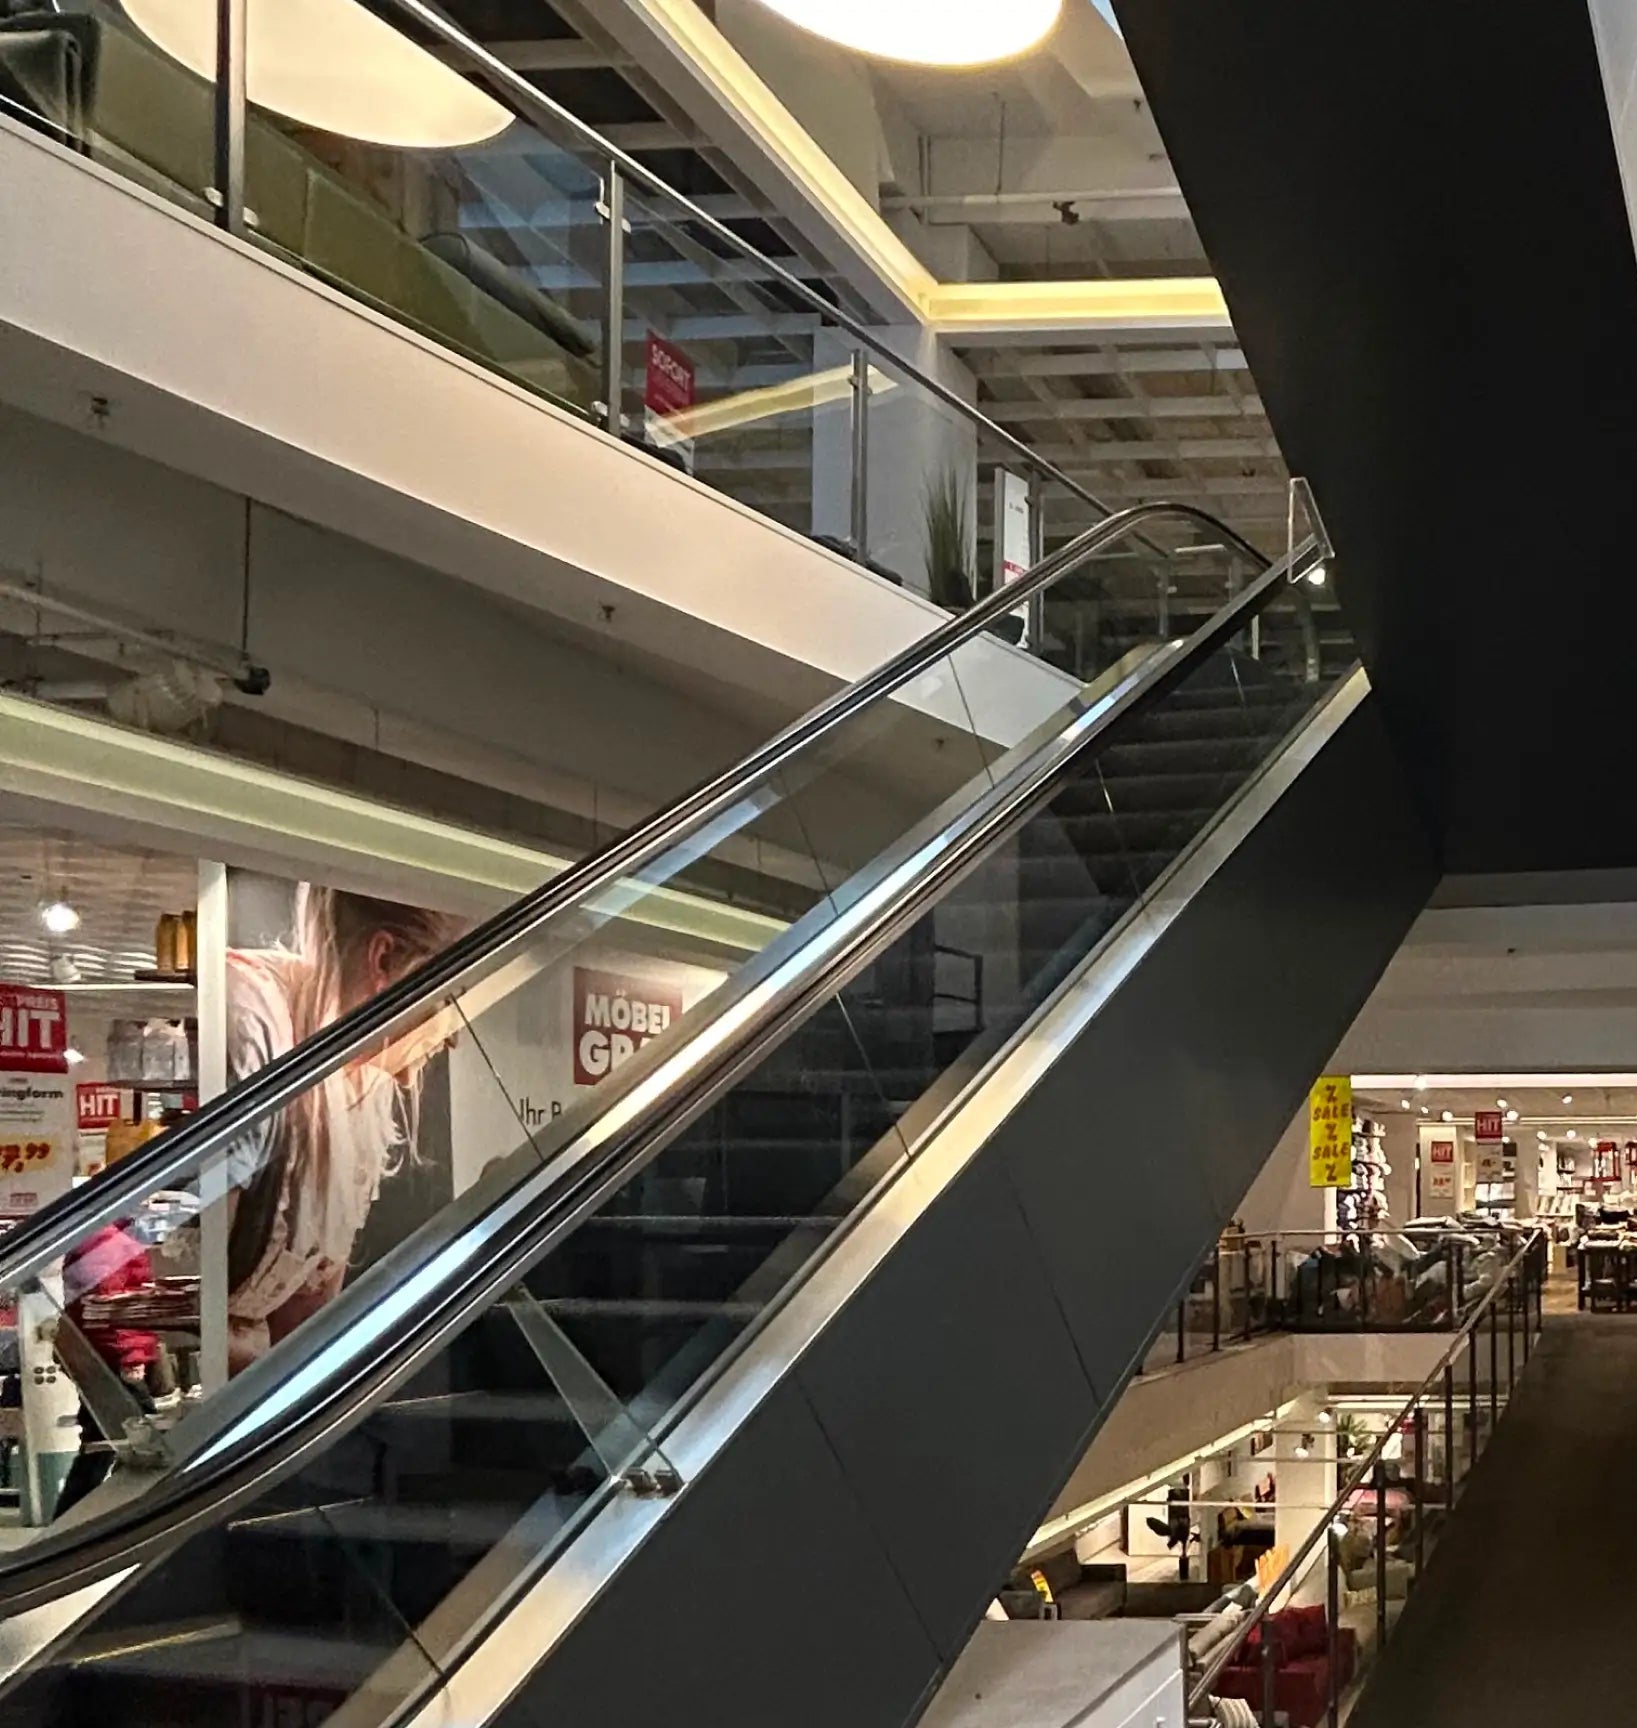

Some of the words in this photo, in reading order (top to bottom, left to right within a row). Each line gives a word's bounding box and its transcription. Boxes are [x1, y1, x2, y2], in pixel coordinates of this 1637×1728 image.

[80, 1095, 118, 1116] HIT
[1313, 1103, 1349, 1121] SALE
[1477, 1118, 1499, 1131] HIT
[1313, 1142, 1348, 1160] SALE
[1432, 1146, 1452, 1160] HIT
